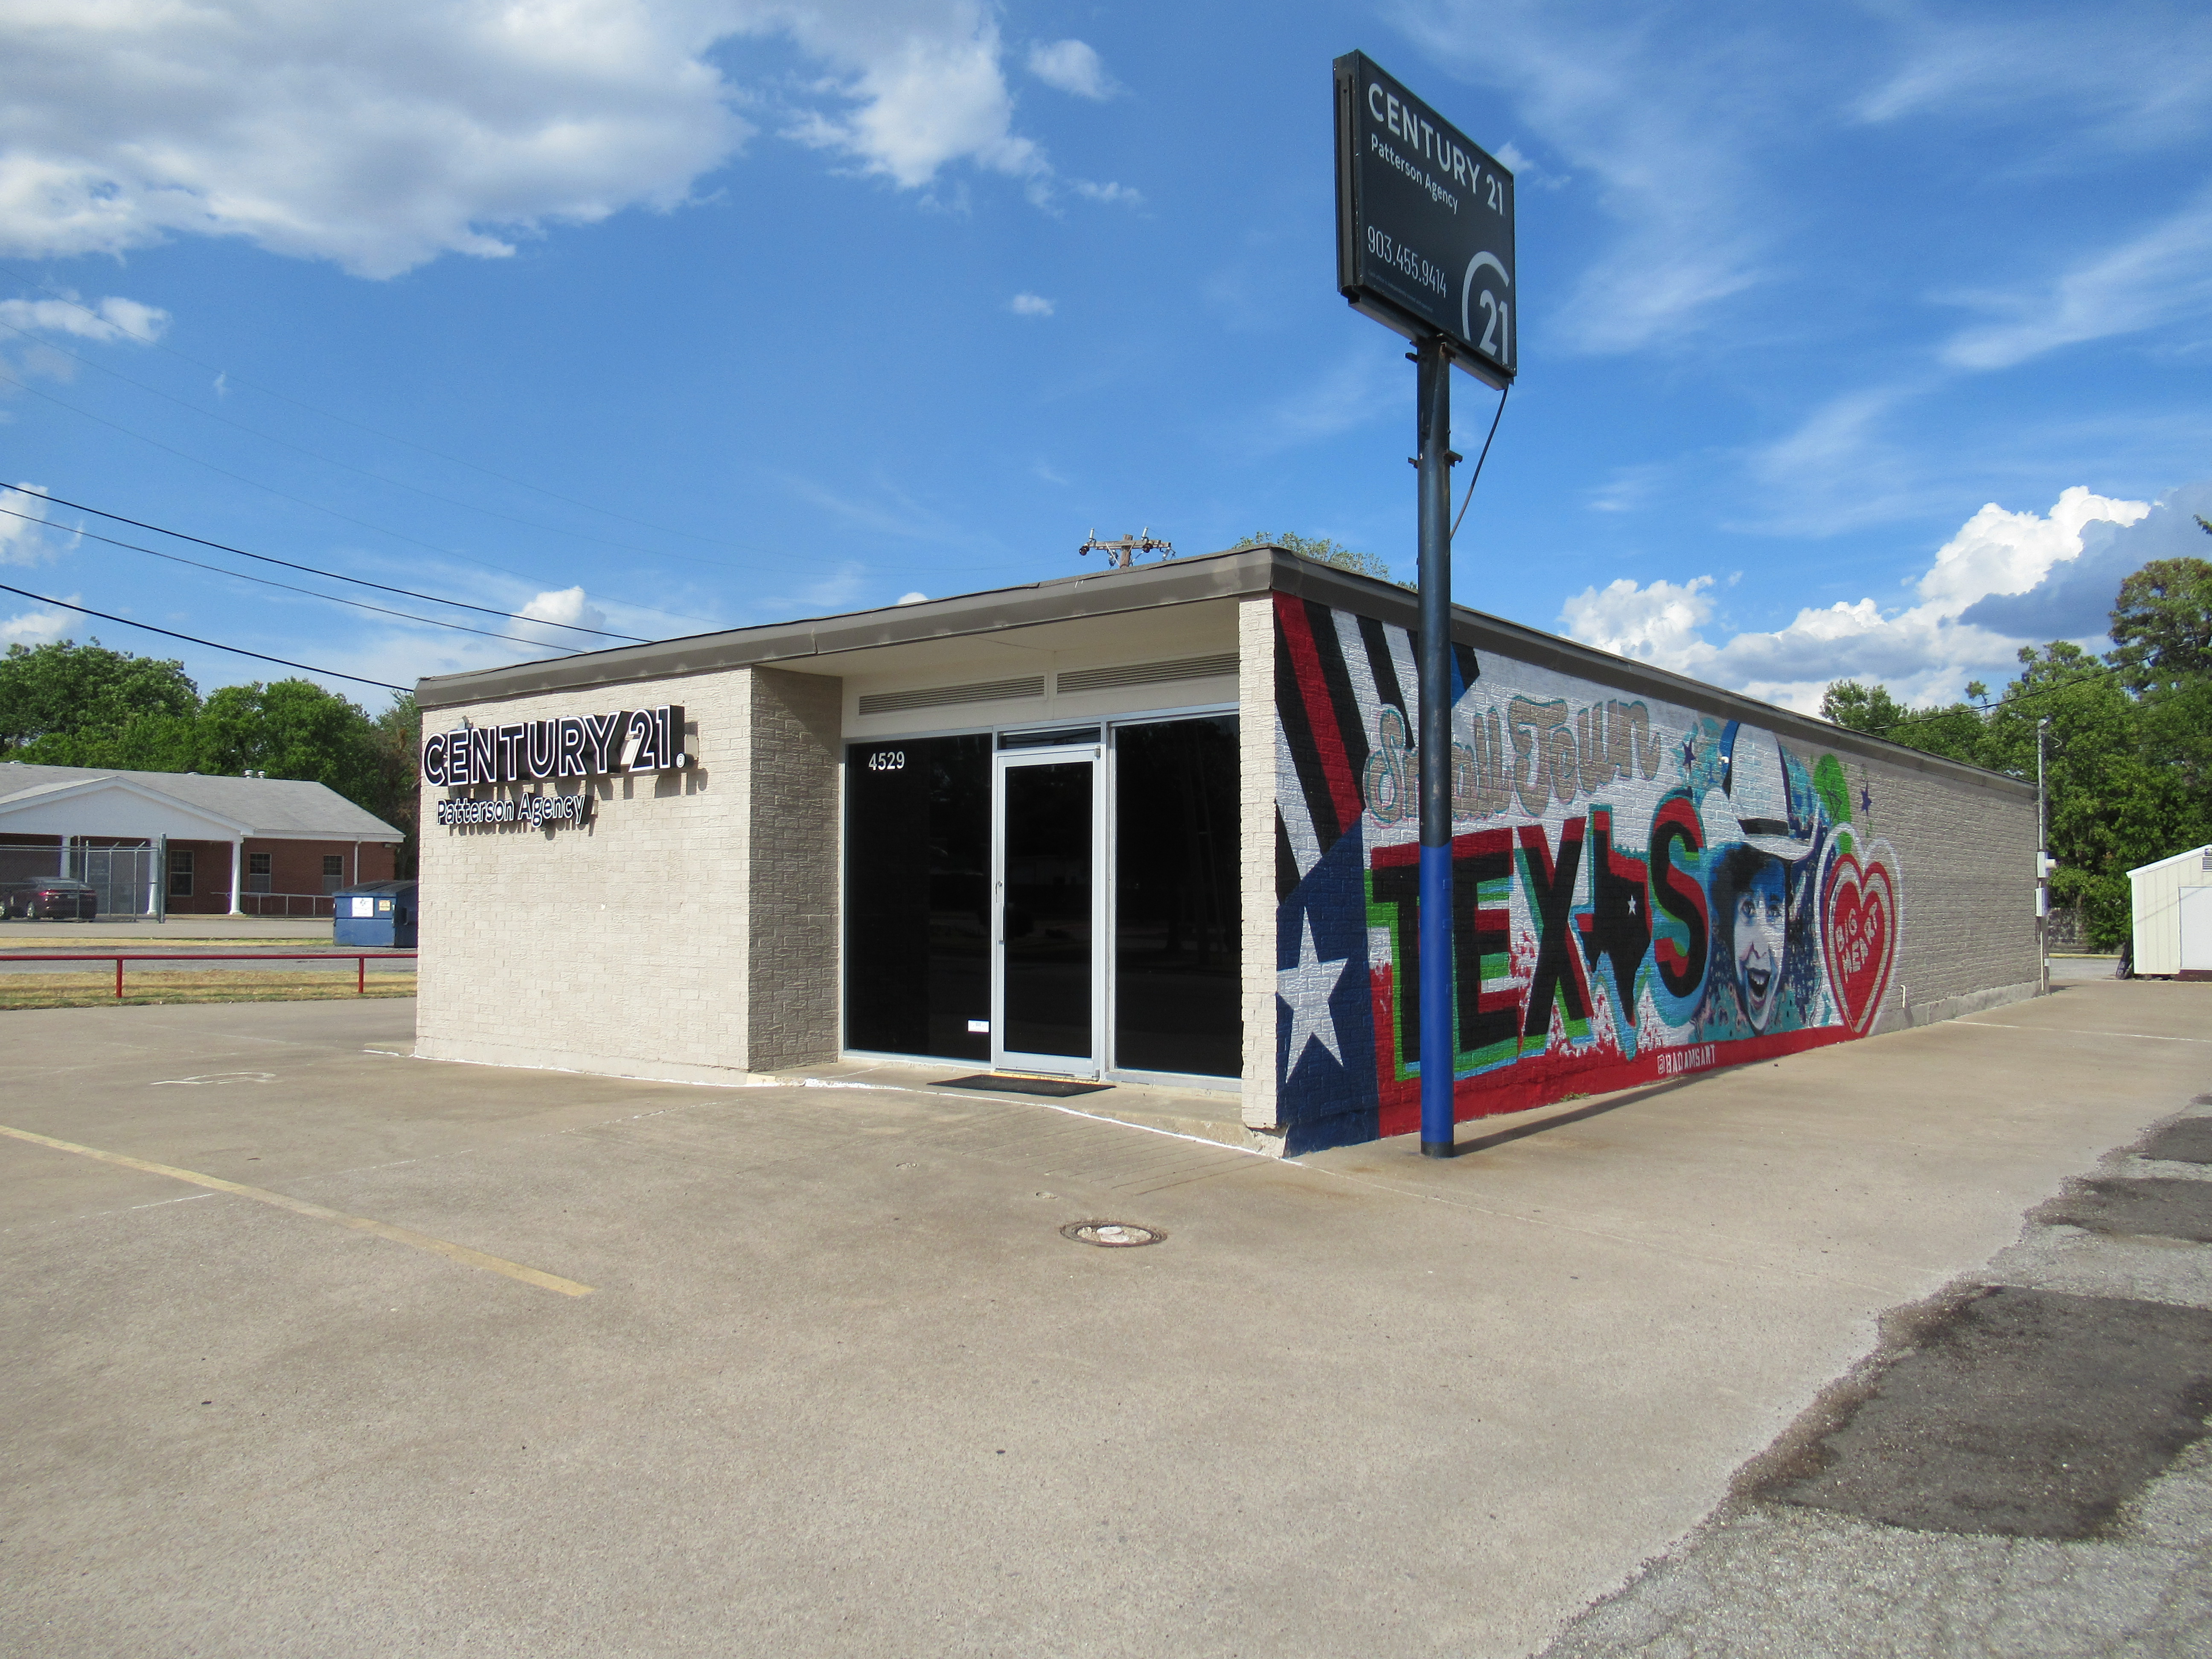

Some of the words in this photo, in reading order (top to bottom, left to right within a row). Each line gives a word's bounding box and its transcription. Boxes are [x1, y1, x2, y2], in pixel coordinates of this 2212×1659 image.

[1368, 83, 1481, 195] CENTURY
[1487, 174, 1503, 216] 21
[1371, 133, 1422, 185] Patterson
[1425, 173, 1458, 215] Agency
[1368, 225, 1447, 298] 903.455.9414
[423, 710, 622, 786] CENTURY
[868, 751, 905, 771] 4529
[436, 796, 514, 826] Patterson
[518, 792, 585, 828] Agency
[1835, 908, 1857, 953] BIG
